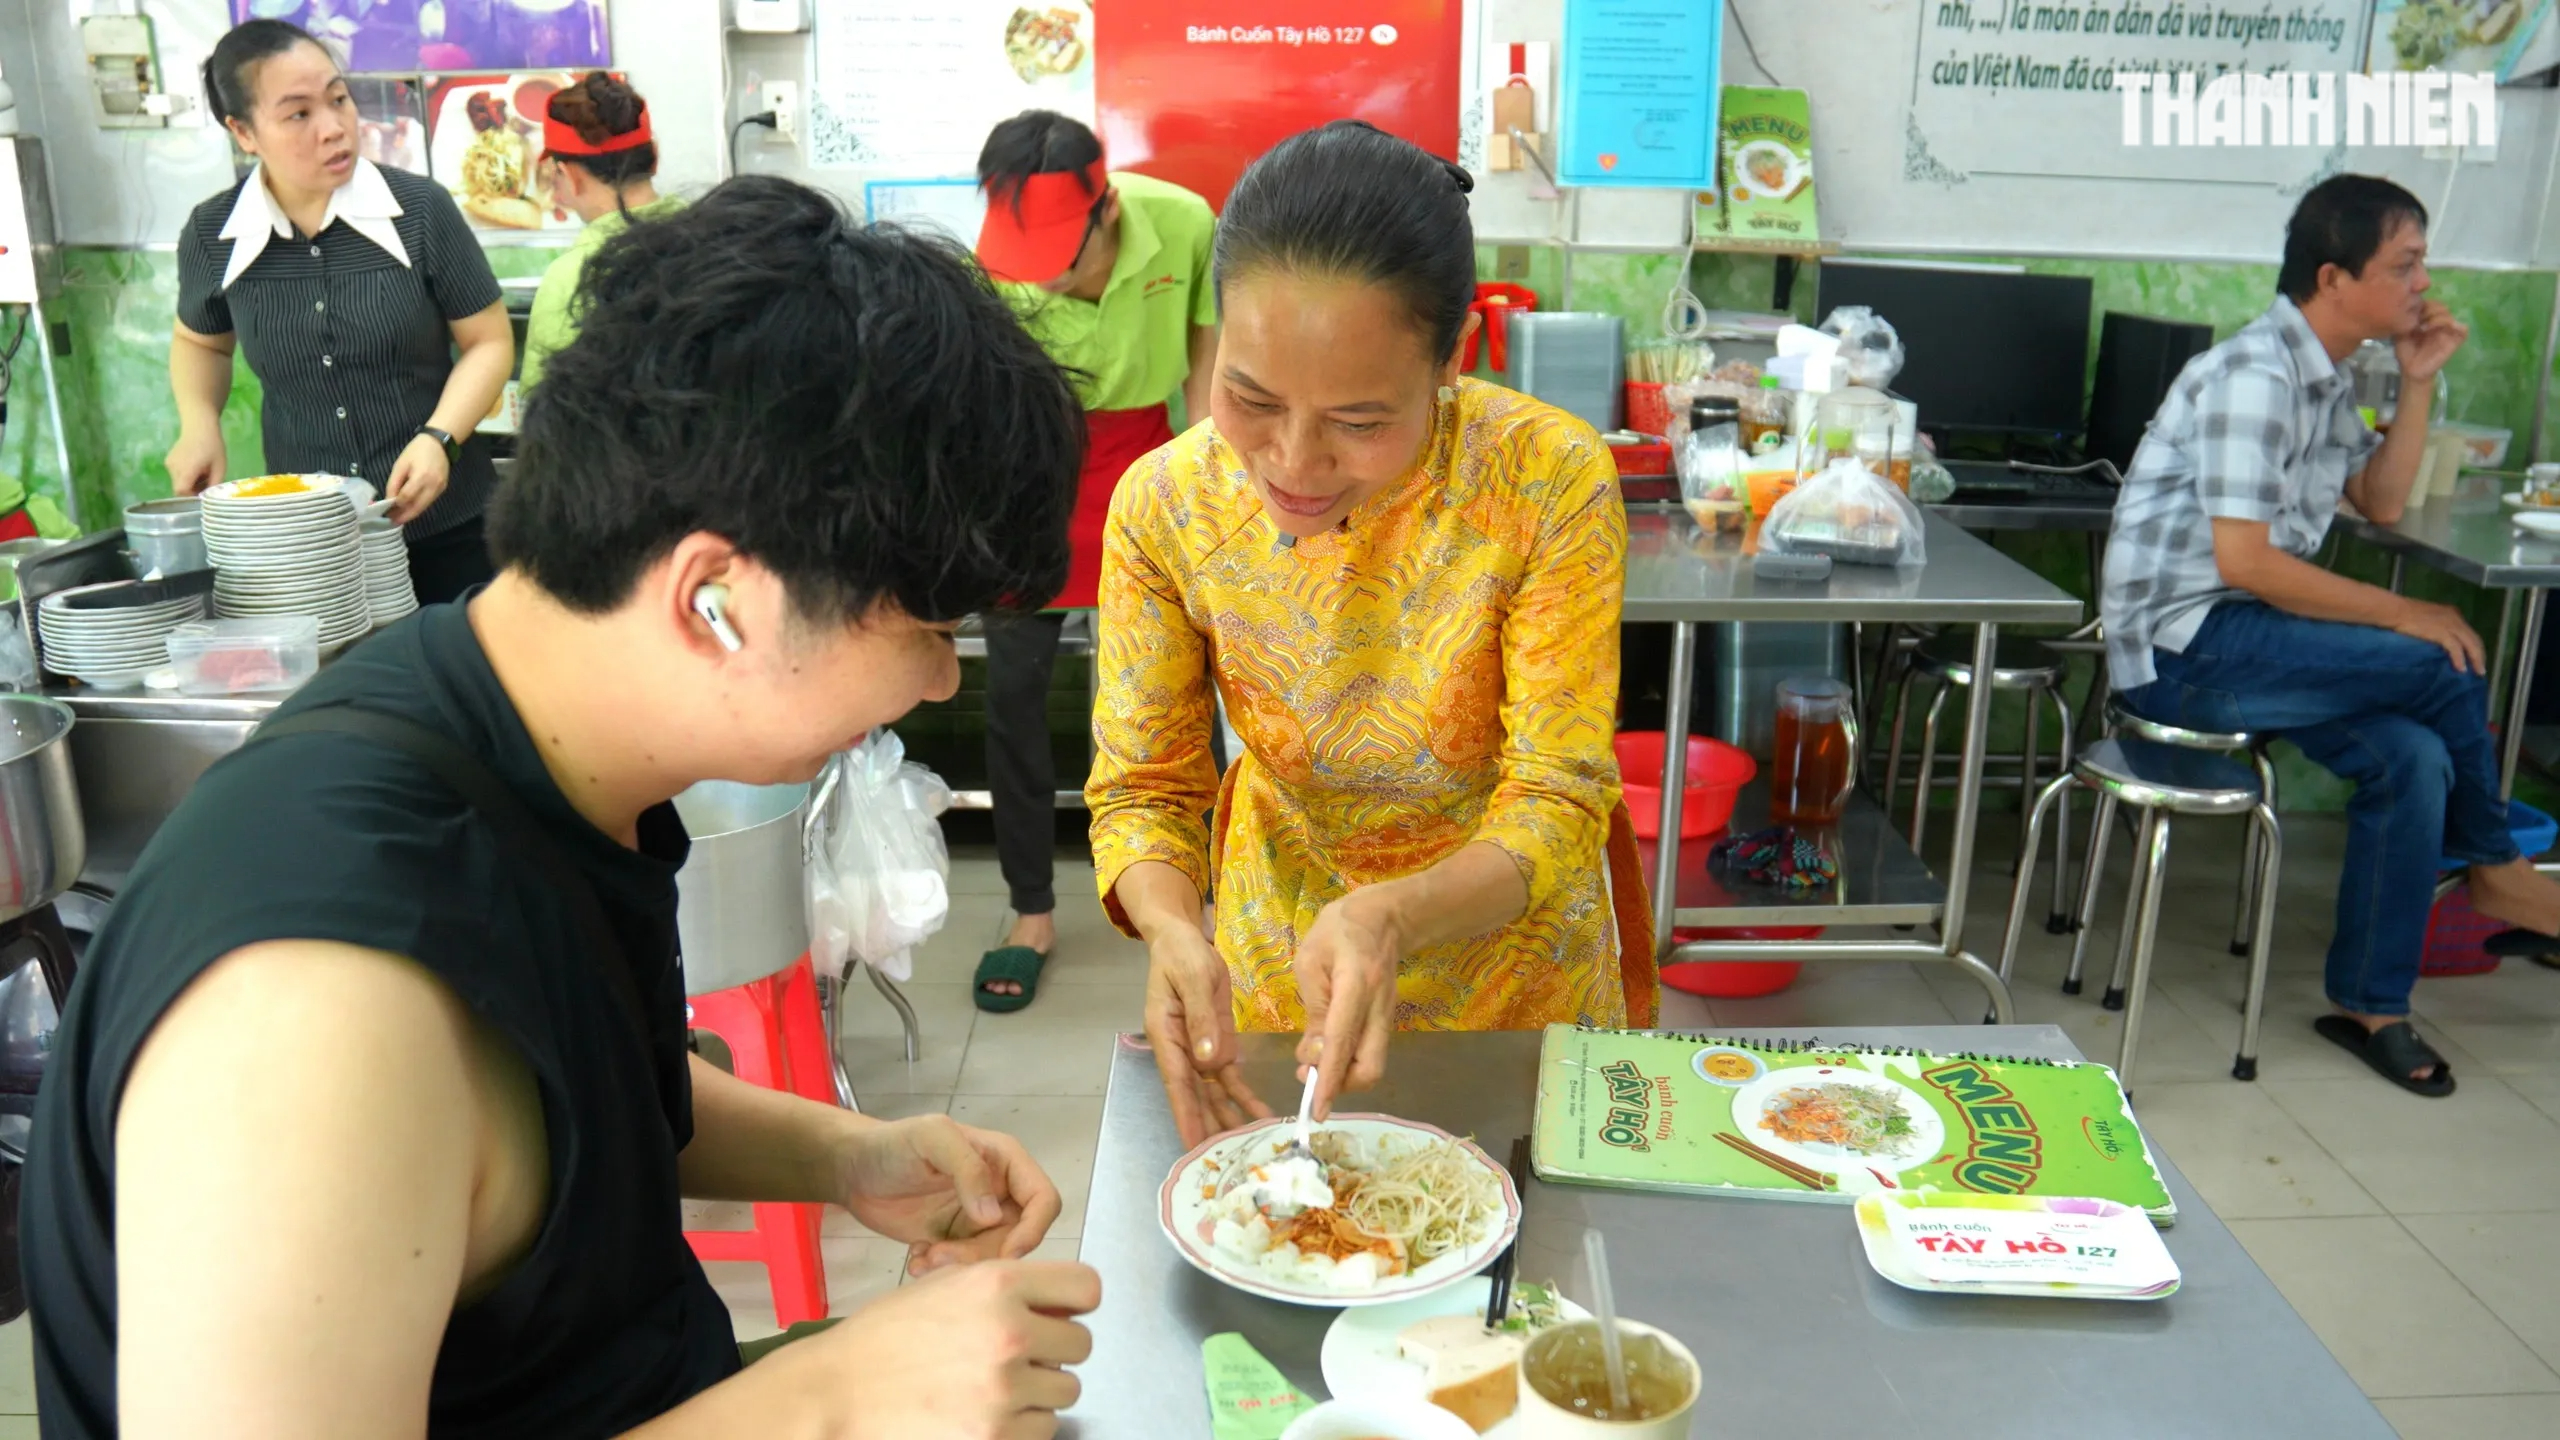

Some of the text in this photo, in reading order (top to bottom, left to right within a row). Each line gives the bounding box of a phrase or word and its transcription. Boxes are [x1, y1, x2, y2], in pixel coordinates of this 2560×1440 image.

[1186, 24, 1365, 48] Bánh Cuốn Tây Hồ 127
[2009, 0, 2032, 30] là
[2034, 0, 2081, 33] món
[2114, 4, 2154, 36] dân
[2187, 8, 2213, 38] và
[2284, 3, 2346, 52] thống
[1931, 49, 1969, 86] của
[1972, 52, 2012, 98] Việt
[2012, 54, 2062, 89] Nam
[2063, 54, 2091, 90] đã
[2092, 57, 2115, 91] có
[1728, 115, 1805, 143] MENU
[1603, 1061, 1651, 1108] TÂY
[1655, 1076, 1678, 1141] bánh cuốn
[1924, 1064, 2040, 1195] MENU
[1915, 1231, 2118, 1258] TÂY HỒ 127
